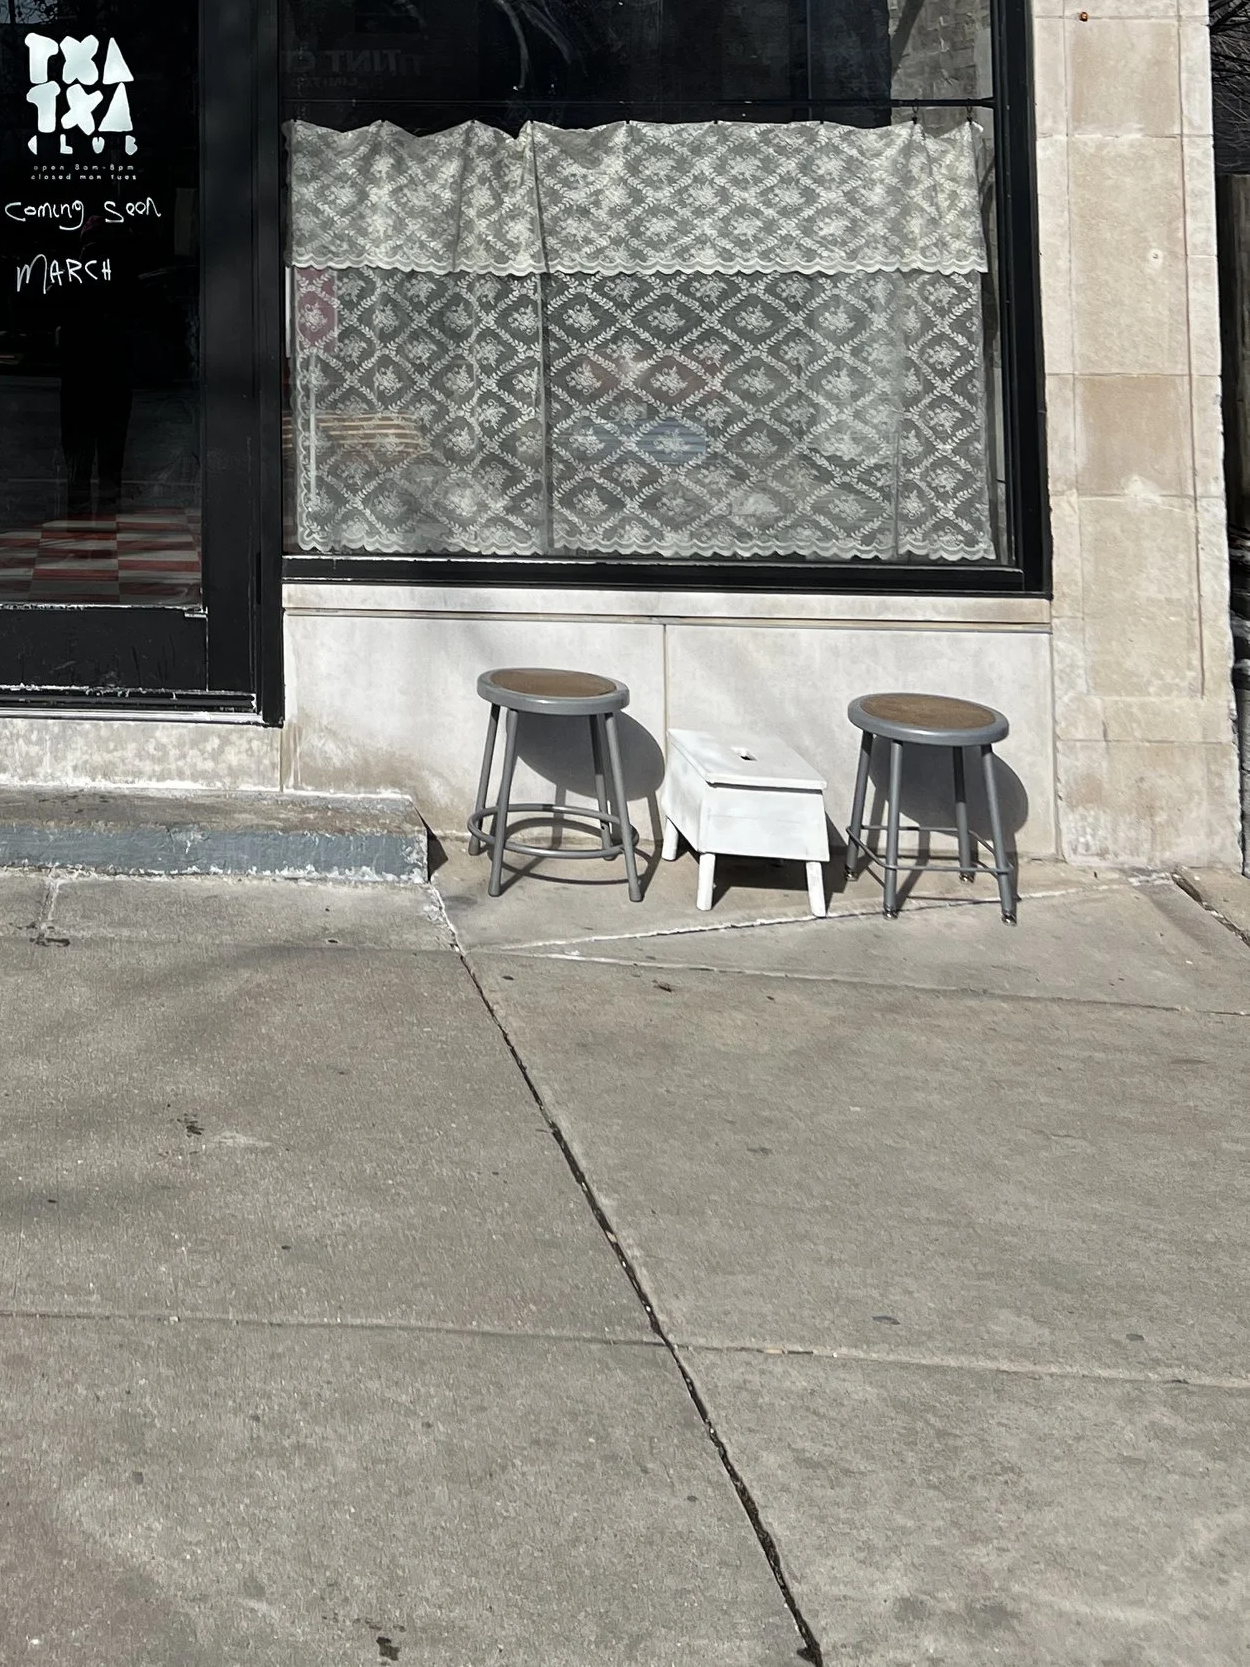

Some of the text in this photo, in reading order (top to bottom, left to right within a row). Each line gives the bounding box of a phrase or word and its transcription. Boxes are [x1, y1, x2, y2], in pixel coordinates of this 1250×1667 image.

[24, 32, 134, 85] TXA
[26, 80, 134, 135] TXA
[27, 133, 138, 156] CLUB
[4, 196, 162, 231] Coming Soon
[16, 253, 112, 295] MARCH
